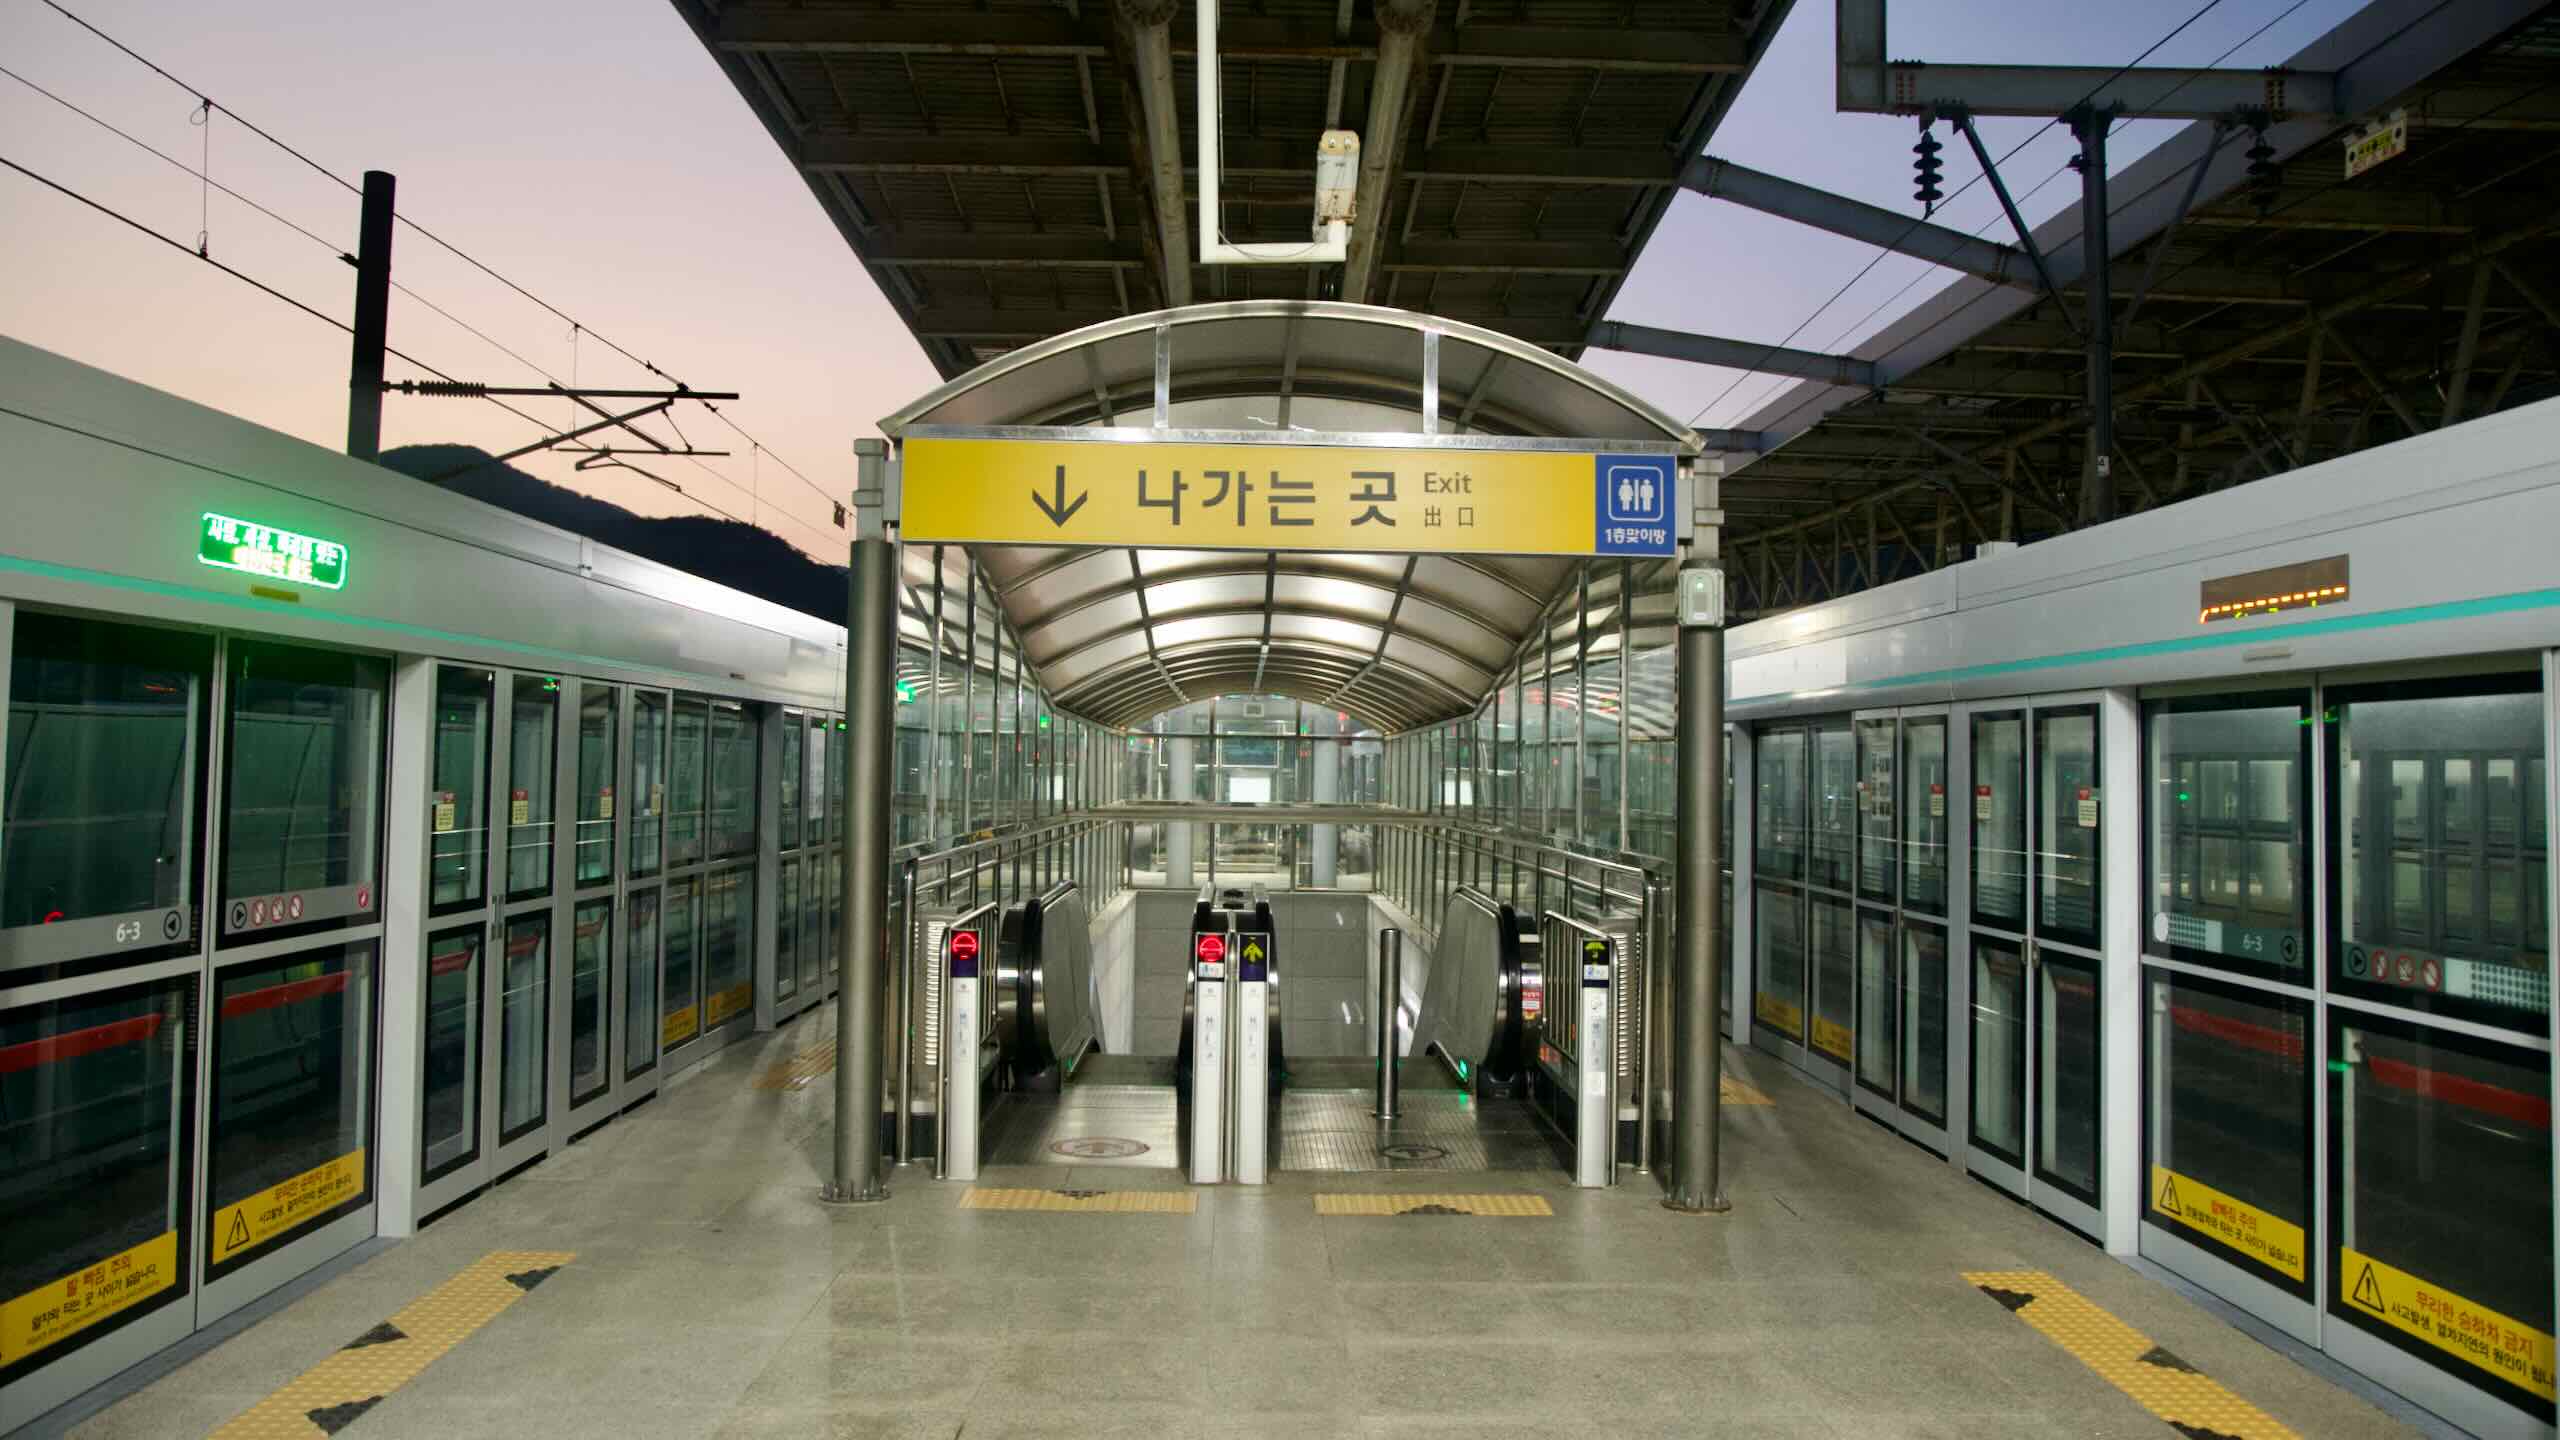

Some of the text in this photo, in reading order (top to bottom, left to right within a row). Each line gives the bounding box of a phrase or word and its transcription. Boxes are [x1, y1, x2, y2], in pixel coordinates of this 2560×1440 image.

[1423, 472, 1472, 493] Exit
[1138, 470, 1397, 527] 나가는 곳
[1424, 506, 1474, 527] 出口
[1605, 527, 1666, 545] 1층맞이방
[116, 921, 141, 943] 6-3
[2242, 933, 2264, 953] 6-3
[2415, 1290, 2534, 1361] 무리한 승하차 금지
[2436, 1321, 2489, 1360] 열차지연의
[2493, 1346, 2527, 1377] 원인이
